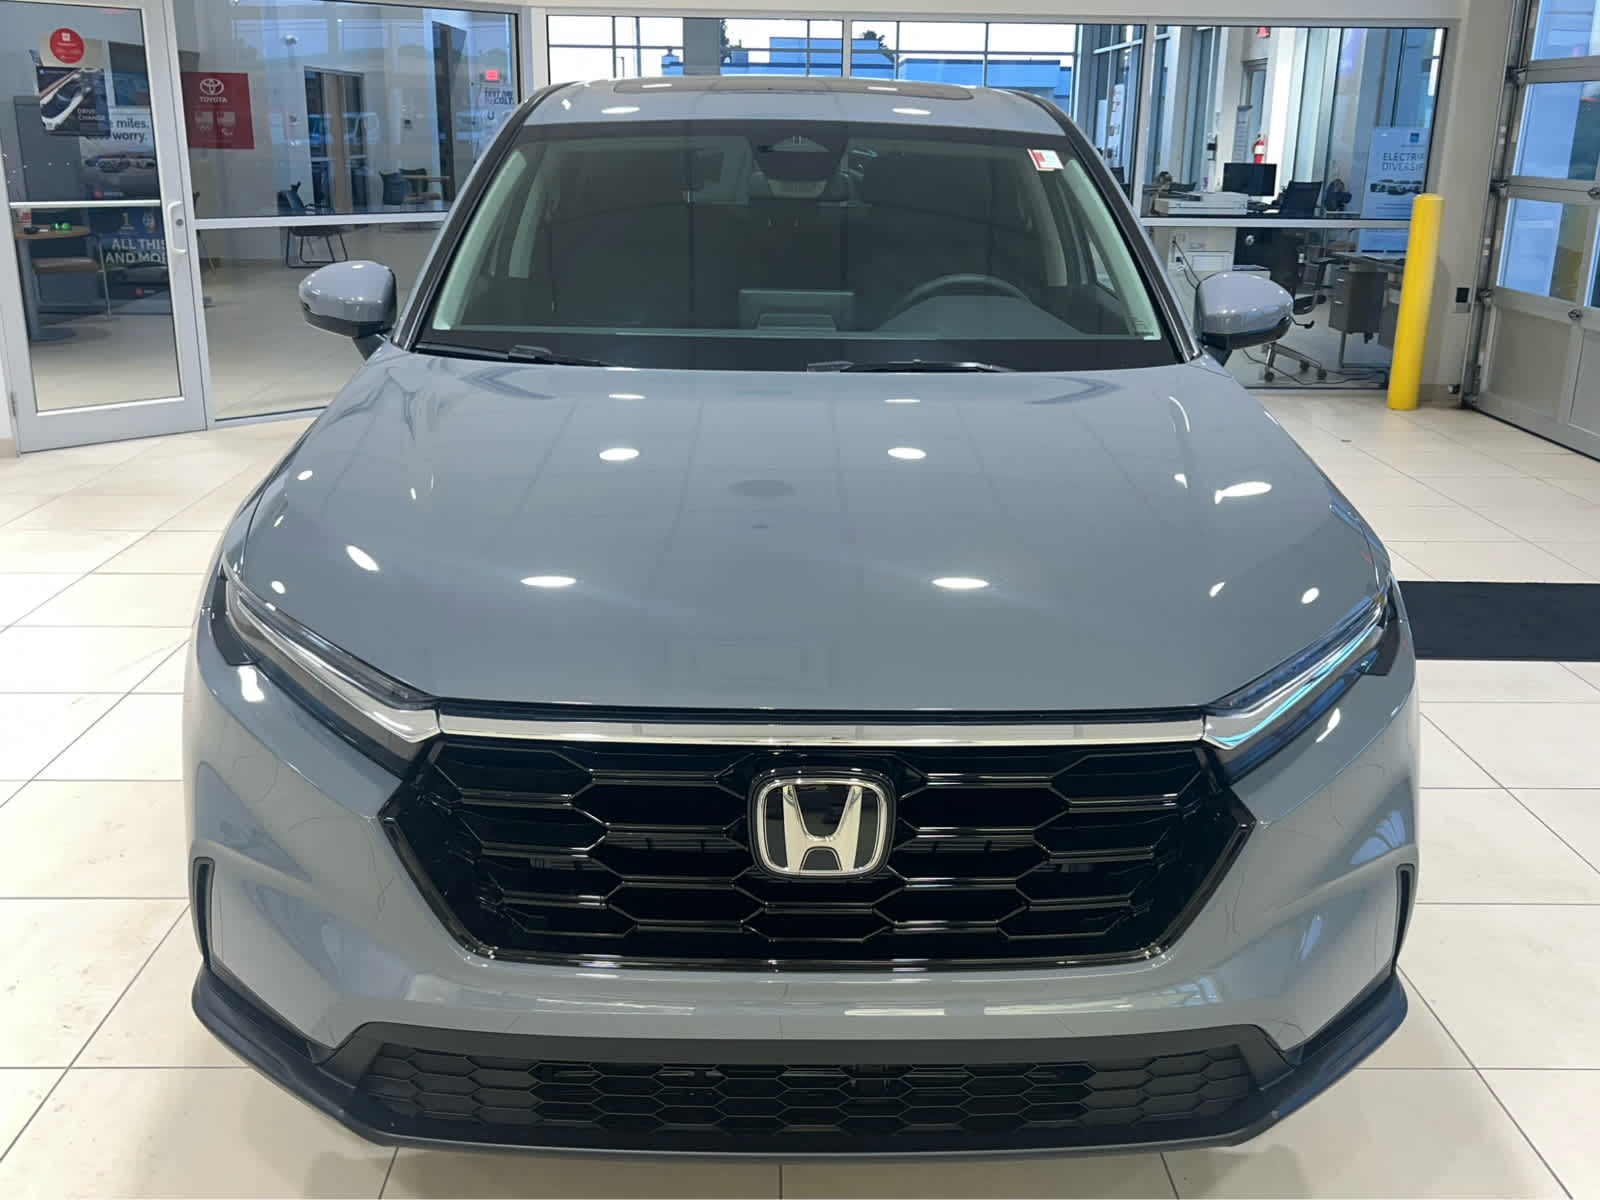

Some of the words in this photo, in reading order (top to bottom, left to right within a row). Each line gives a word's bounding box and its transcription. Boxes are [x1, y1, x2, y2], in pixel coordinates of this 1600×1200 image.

[199, 96, 229, 104] TOYOTA
[116, 117, 150, 129] miles.
[111, 131, 148, 143] worry.
[111, 238, 136, 250] ALL
[105, 251, 136, 265] AND
